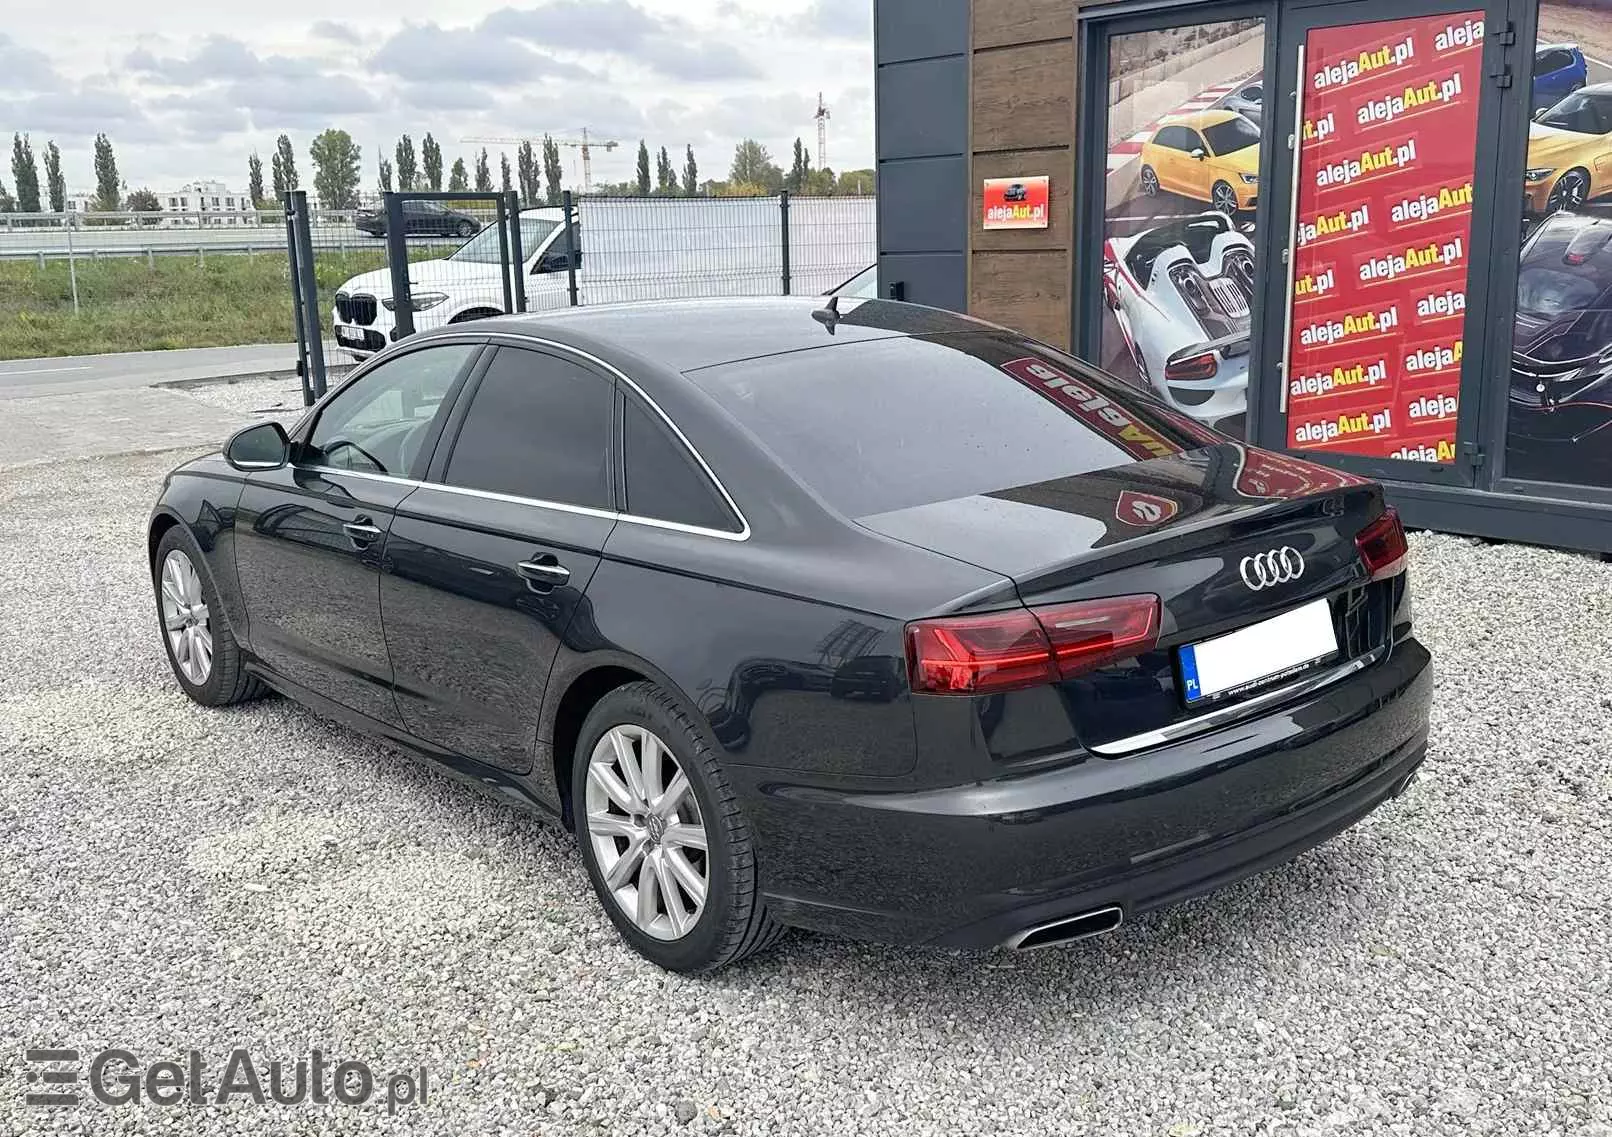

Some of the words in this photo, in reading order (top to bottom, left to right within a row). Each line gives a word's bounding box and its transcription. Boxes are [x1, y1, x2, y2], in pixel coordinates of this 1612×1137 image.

[1435, 20, 1484, 51] aleja
[1314, 37, 1414, 89] alejaAut.pl
[1358, 73, 1461, 121] alejaAut.pl
[1316, 139, 1416, 187] alejaAut.pl
[987, 203, 1045, 221] alejaAut.pl
[1391, 183, 1473, 222] alejaAut
[1359, 238, 1463, 280] alejaAut.pl
[1417, 291, 1466, 316] aleja
[1300, 306, 1398, 345] alejaAut.pl
[1290, 359, 1387, 396] alejaAut.pl
[1409, 394, 1456, 418] aleja
[1295, 408, 1392, 442] alejaAut.pl
[1187, 680, 1198, 690] PL
